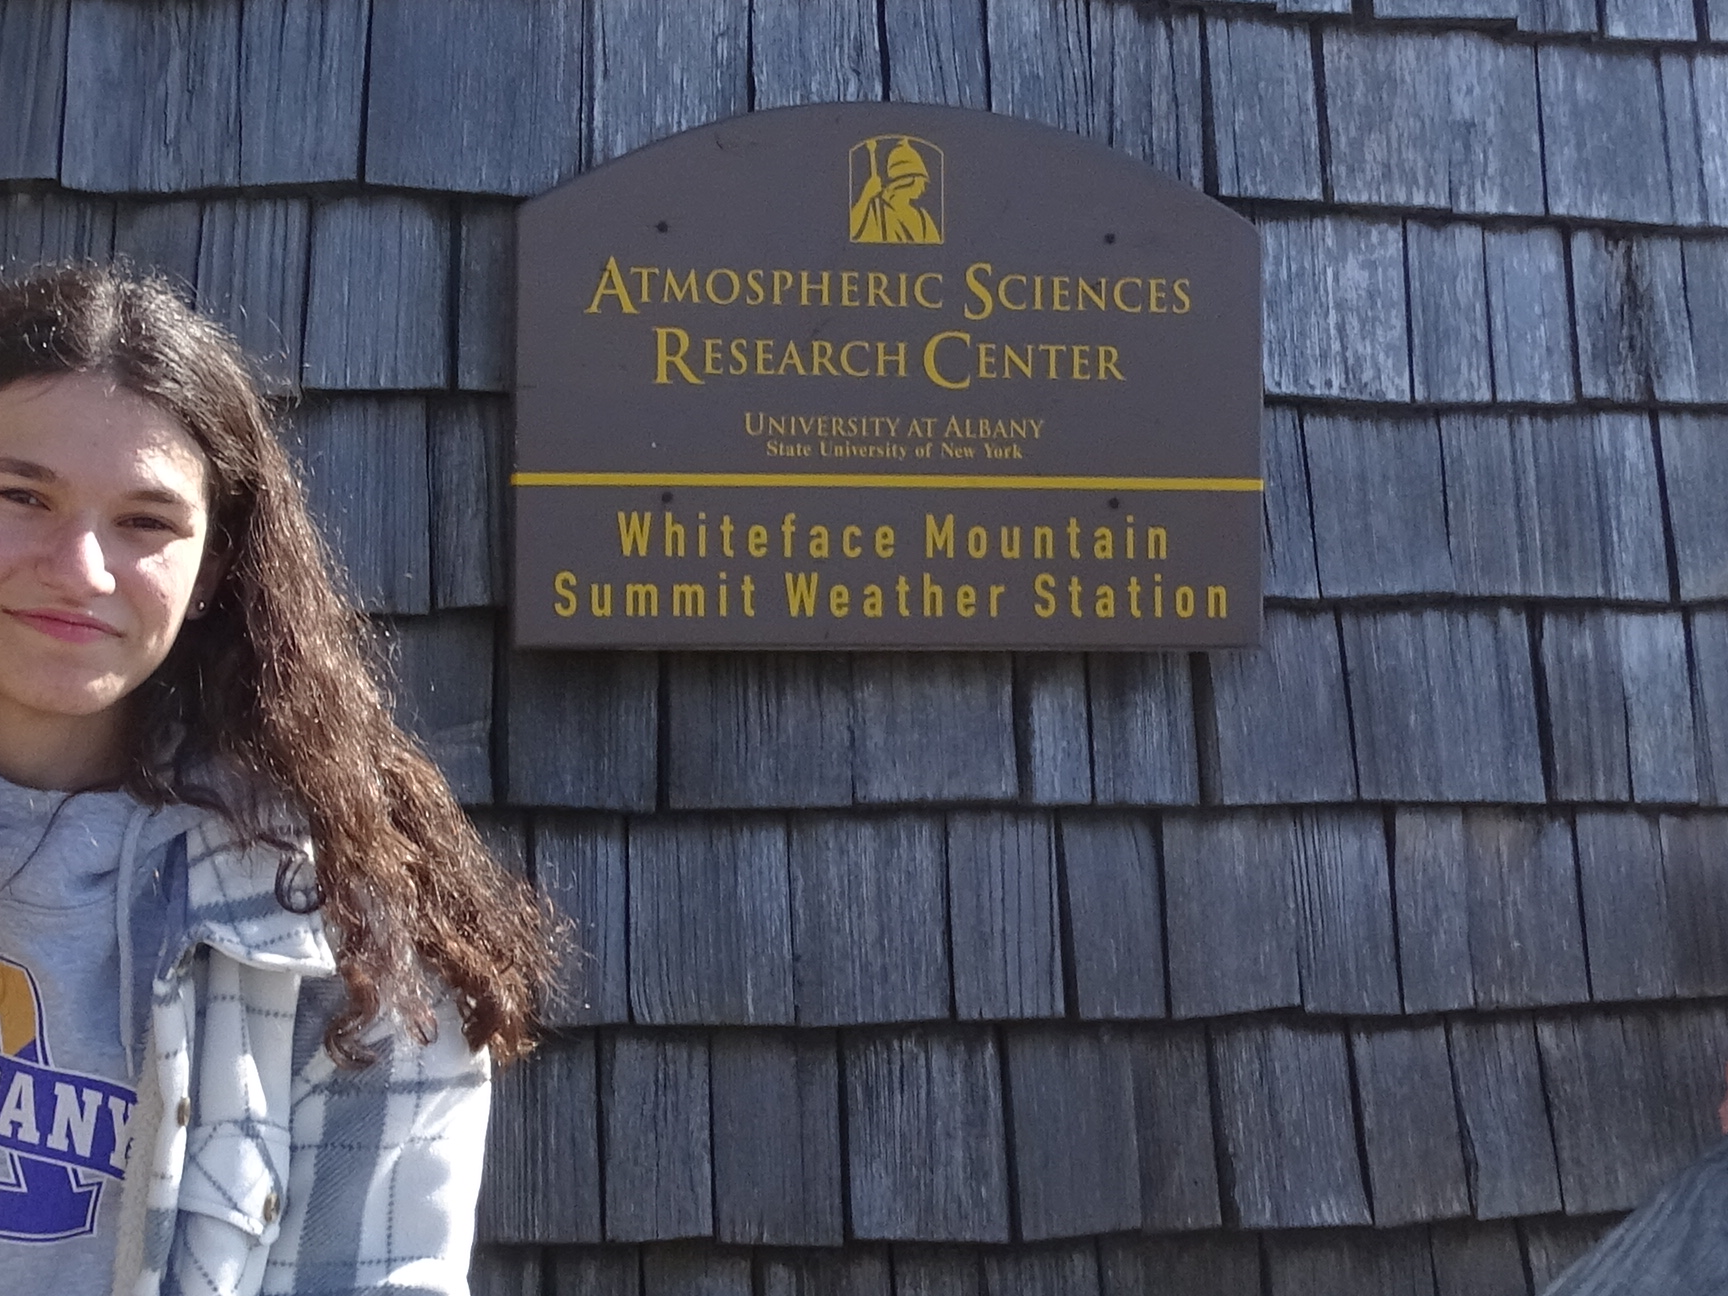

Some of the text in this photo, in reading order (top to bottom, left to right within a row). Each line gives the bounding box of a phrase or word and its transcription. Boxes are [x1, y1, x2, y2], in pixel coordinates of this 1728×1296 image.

[584, 255, 1192, 321] ATMOSPHERIC SCIENCES
[652, 325, 1126, 391] RESEARCH CENTER
[744, 411, 1044, 441] UNIVERSITY AT ALBANY
[766, 440, 1023, 462] State University of New York
[617, 511, 1168, 560] Whiteface Mountain
[554, 570, 1229, 619] Summit Weather Station
